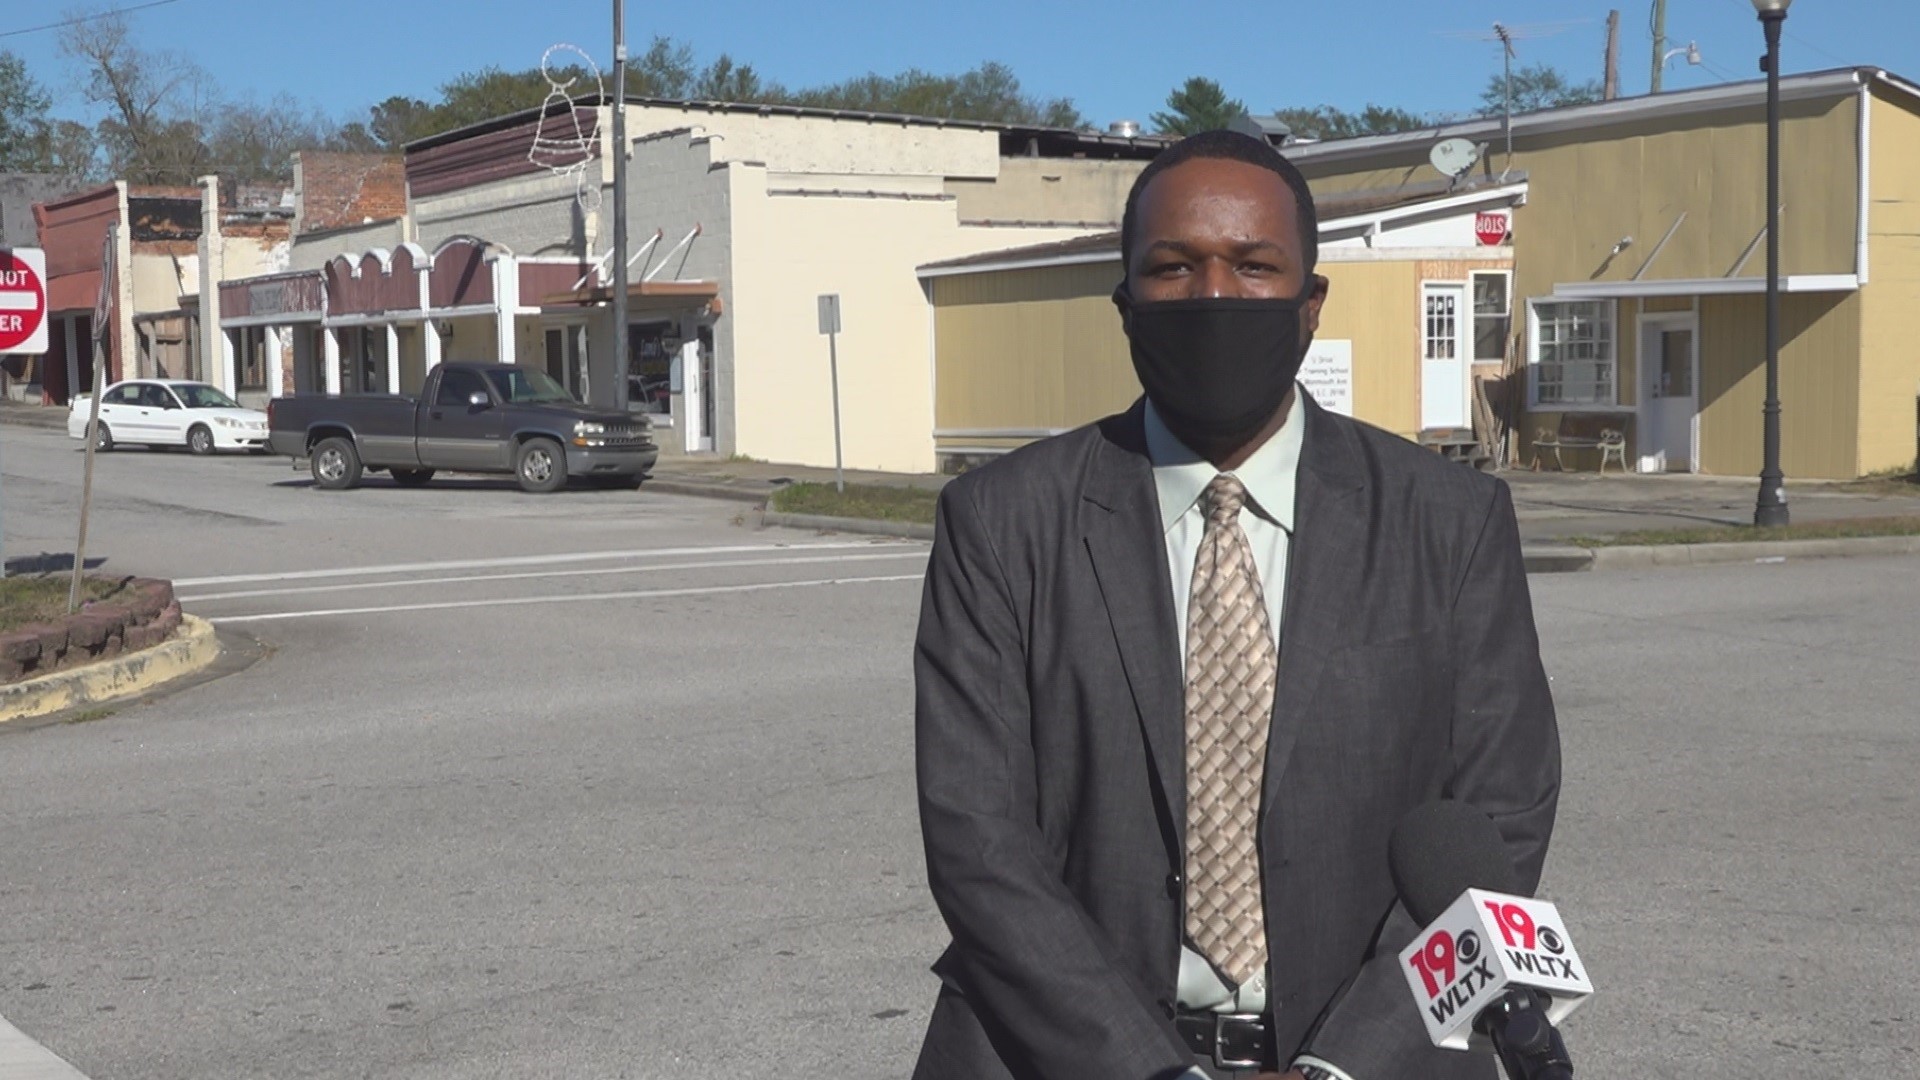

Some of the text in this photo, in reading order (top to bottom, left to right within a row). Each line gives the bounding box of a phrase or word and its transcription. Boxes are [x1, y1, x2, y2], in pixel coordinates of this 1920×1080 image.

[1476, 216, 1504, 234] STOP
[1484, 900, 1536, 951] 19
[1409, 929, 1456, 1001] 19
[1505, 949, 1581, 981] WLTX
[1429, 956, 1496, 1026] WLTX
